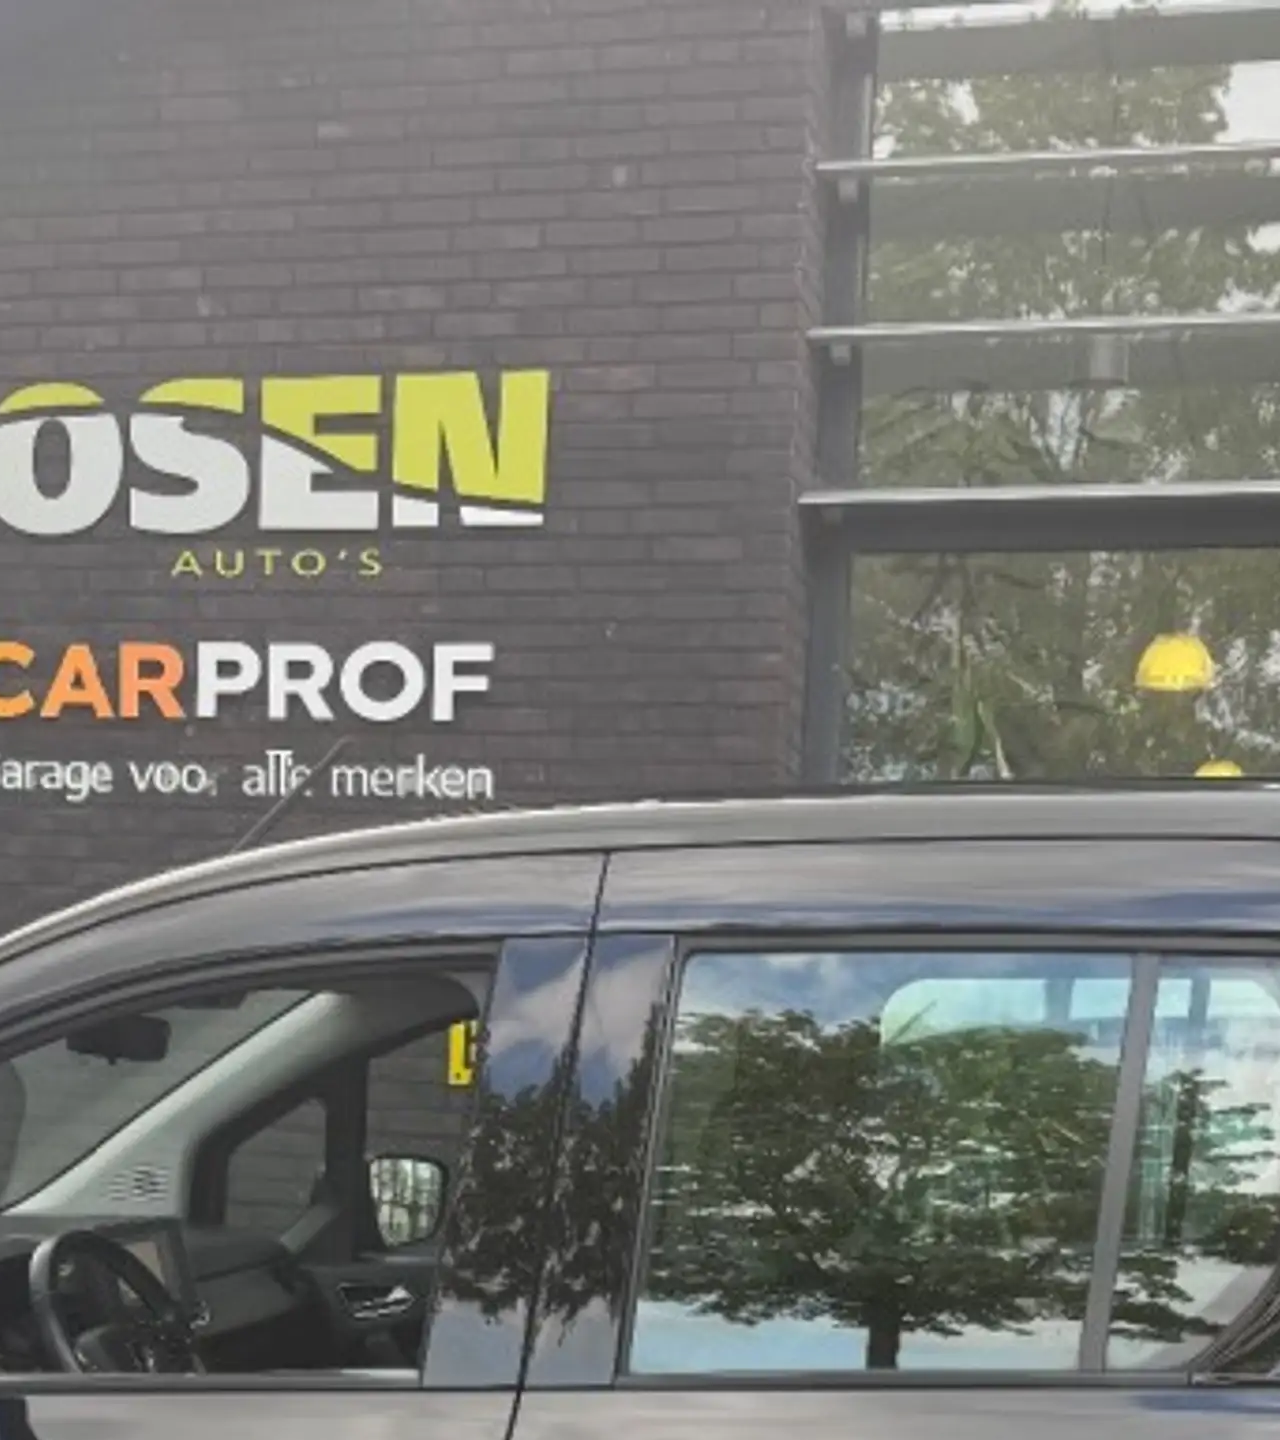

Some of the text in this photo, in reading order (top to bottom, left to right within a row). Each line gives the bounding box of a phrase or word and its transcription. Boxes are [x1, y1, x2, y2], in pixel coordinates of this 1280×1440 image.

[170, 547, 384, 578] AUTO'S
[129, 764, 224, 798] voo
[331, 754, 495, 801] merken
